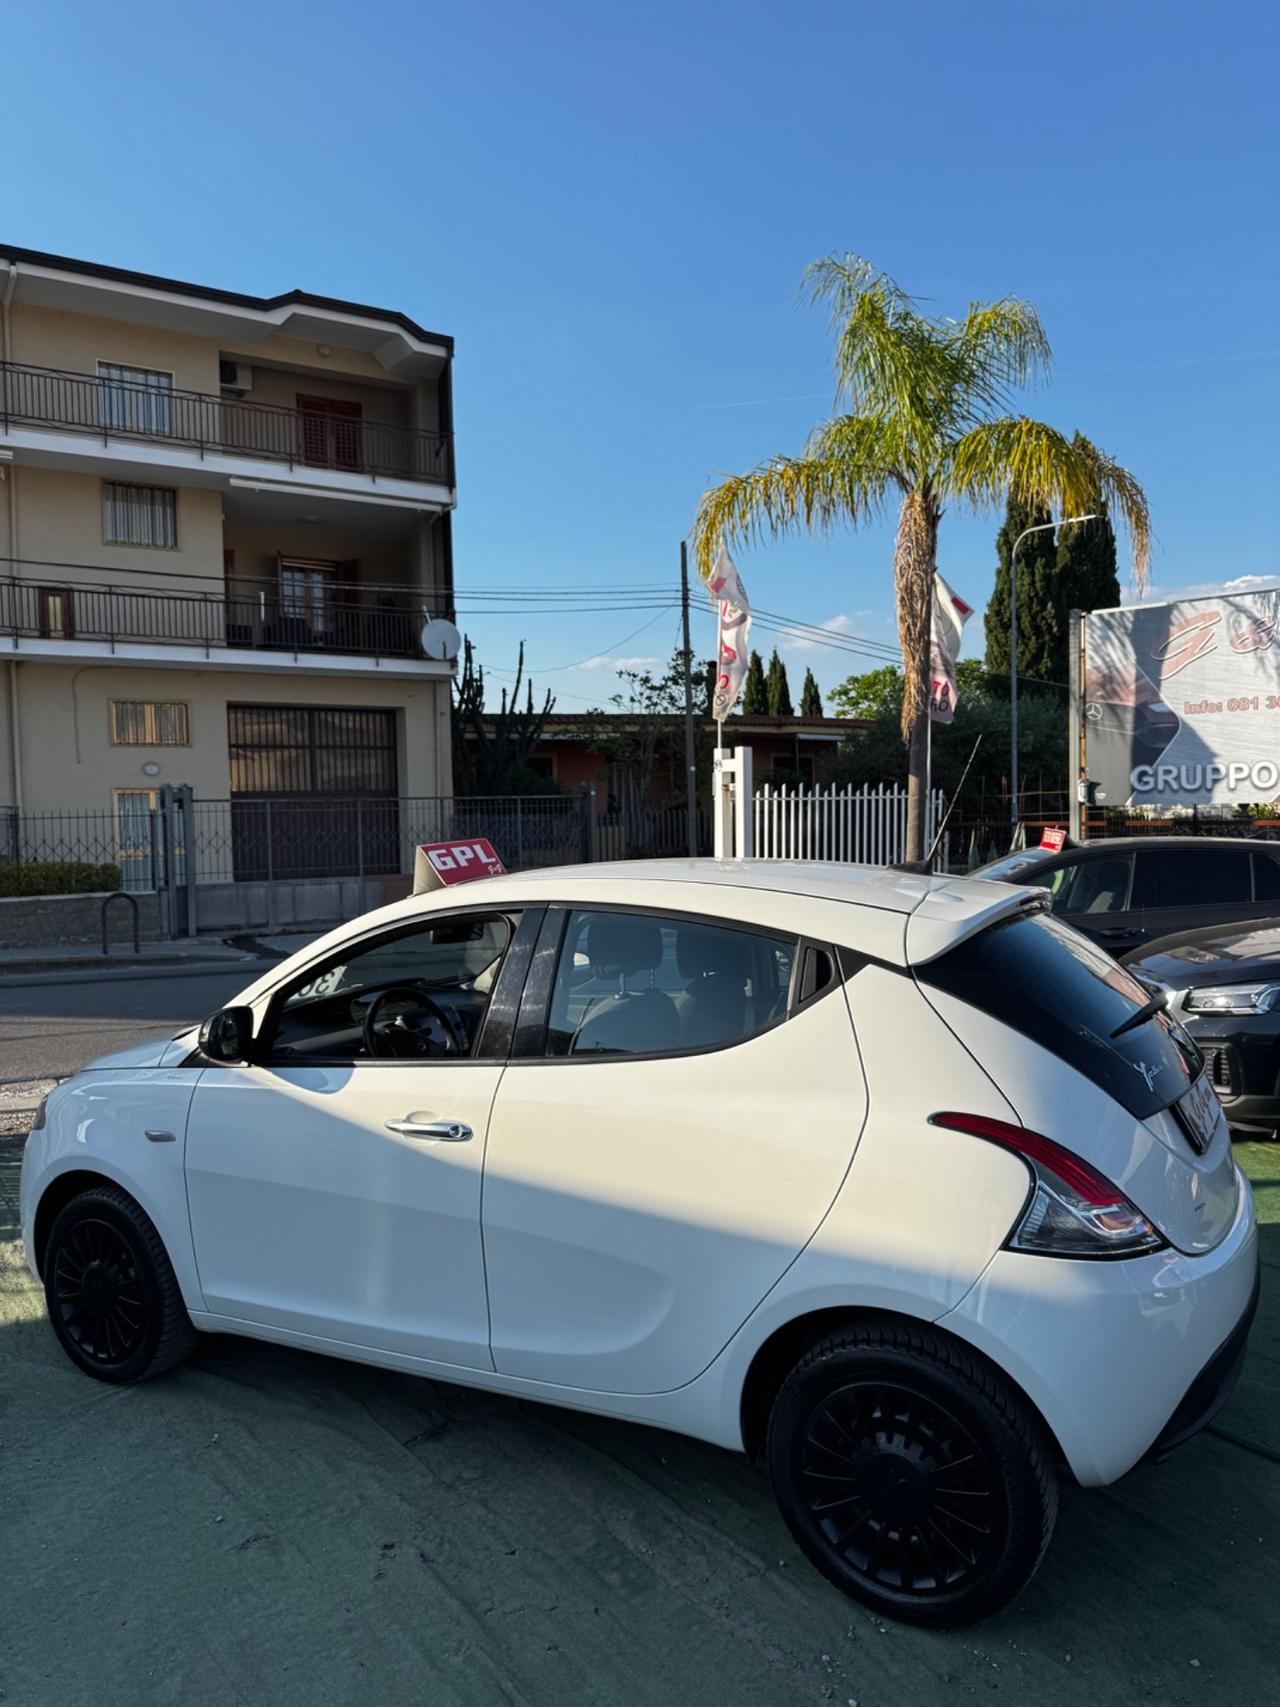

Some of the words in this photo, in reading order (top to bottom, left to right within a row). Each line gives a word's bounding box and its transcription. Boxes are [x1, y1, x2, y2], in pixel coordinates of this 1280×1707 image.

[1184, 700, 1223, 715] Info:
[1227, 696, 1260, 712] 081
[1129, 760, 1279, 792] GRUPPO
[427, 844, 497, 871] GPL
